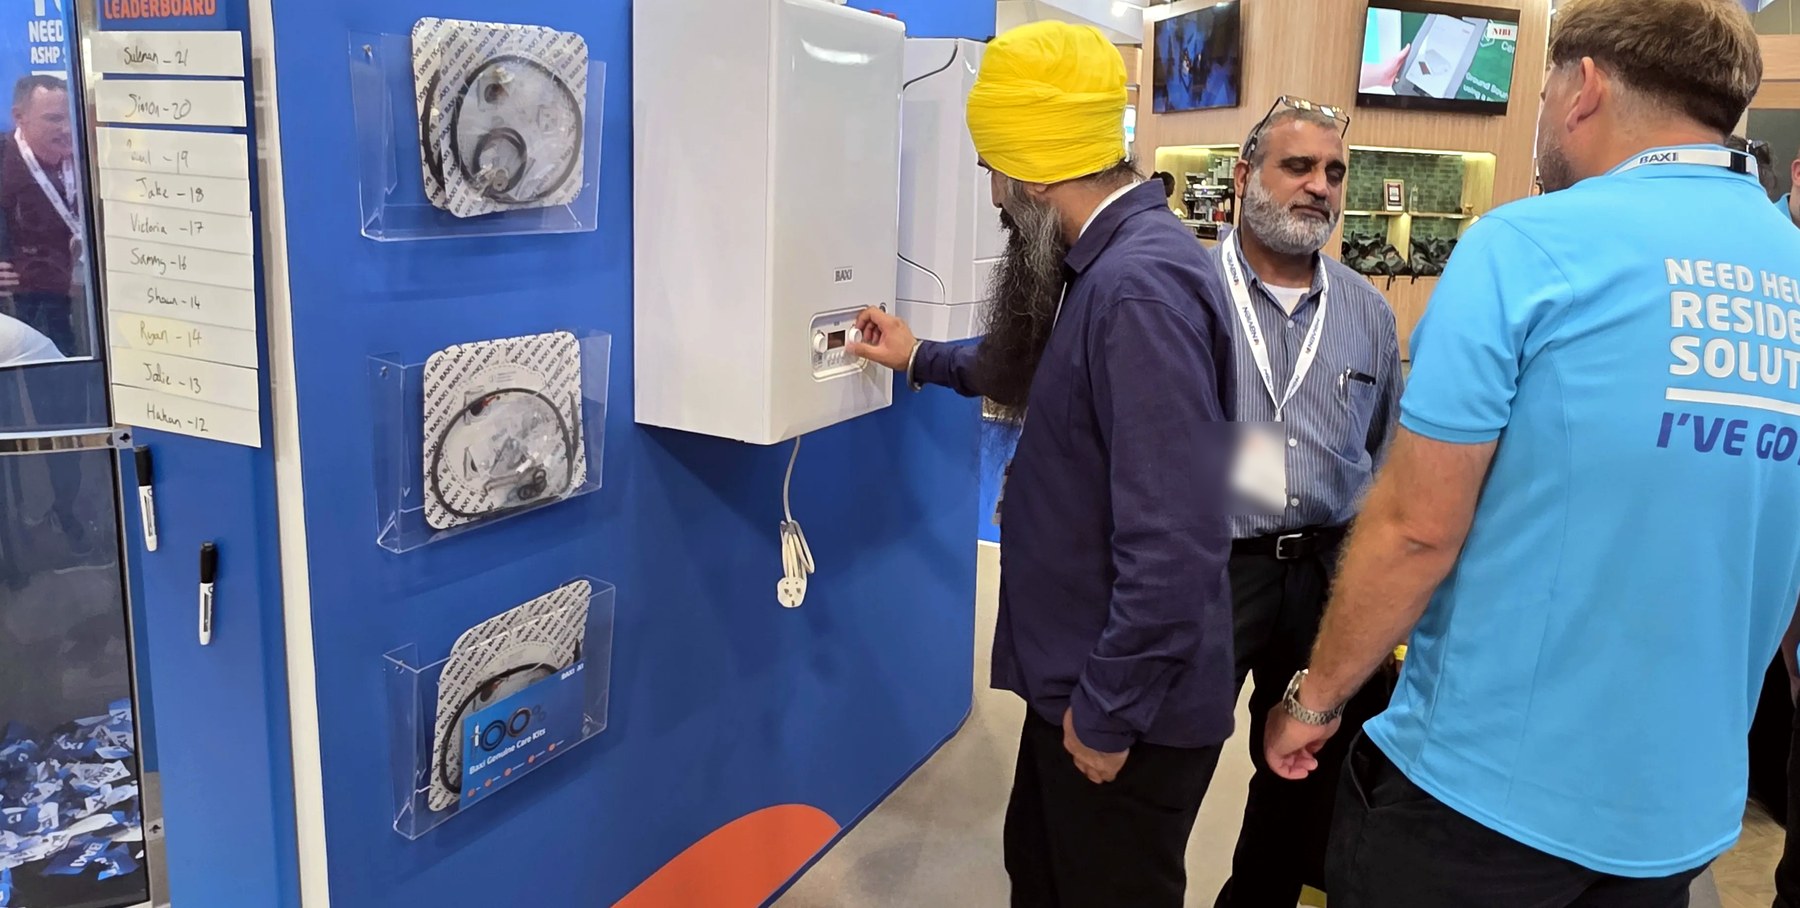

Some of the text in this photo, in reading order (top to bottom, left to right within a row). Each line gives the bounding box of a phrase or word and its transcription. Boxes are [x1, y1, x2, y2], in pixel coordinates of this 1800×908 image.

[104, 0, 217, 19] LEADERBOARD
[28, 20, 64, 43] NEED
[31, 46, 60, 64] ASHP
[1639, 151, 1679, 164] BAXI
[130, 213, 167, 235] Victoria
[834, 268, 853, 283] BAXI
[1664, 258, 1754, 293] NEED
[1670, 291, 1800, 346] RESIDE
[482, 347, 497, 364] BAXI
[1669, 335, 1800, 390] SOLUT
[426, 381, 441, 399] BAXI
[439, 364, 454, 382] BAXI
[434, 390, 449, 408] BAXI
[448, 373, 463, 390] BAXI
[461, 356, 476, 373] BAXI
[429, 415, 444, 433] BAXI
[1656, 412, 1800, 466] I'VE GO
[516, 736, 532, 749] Care
